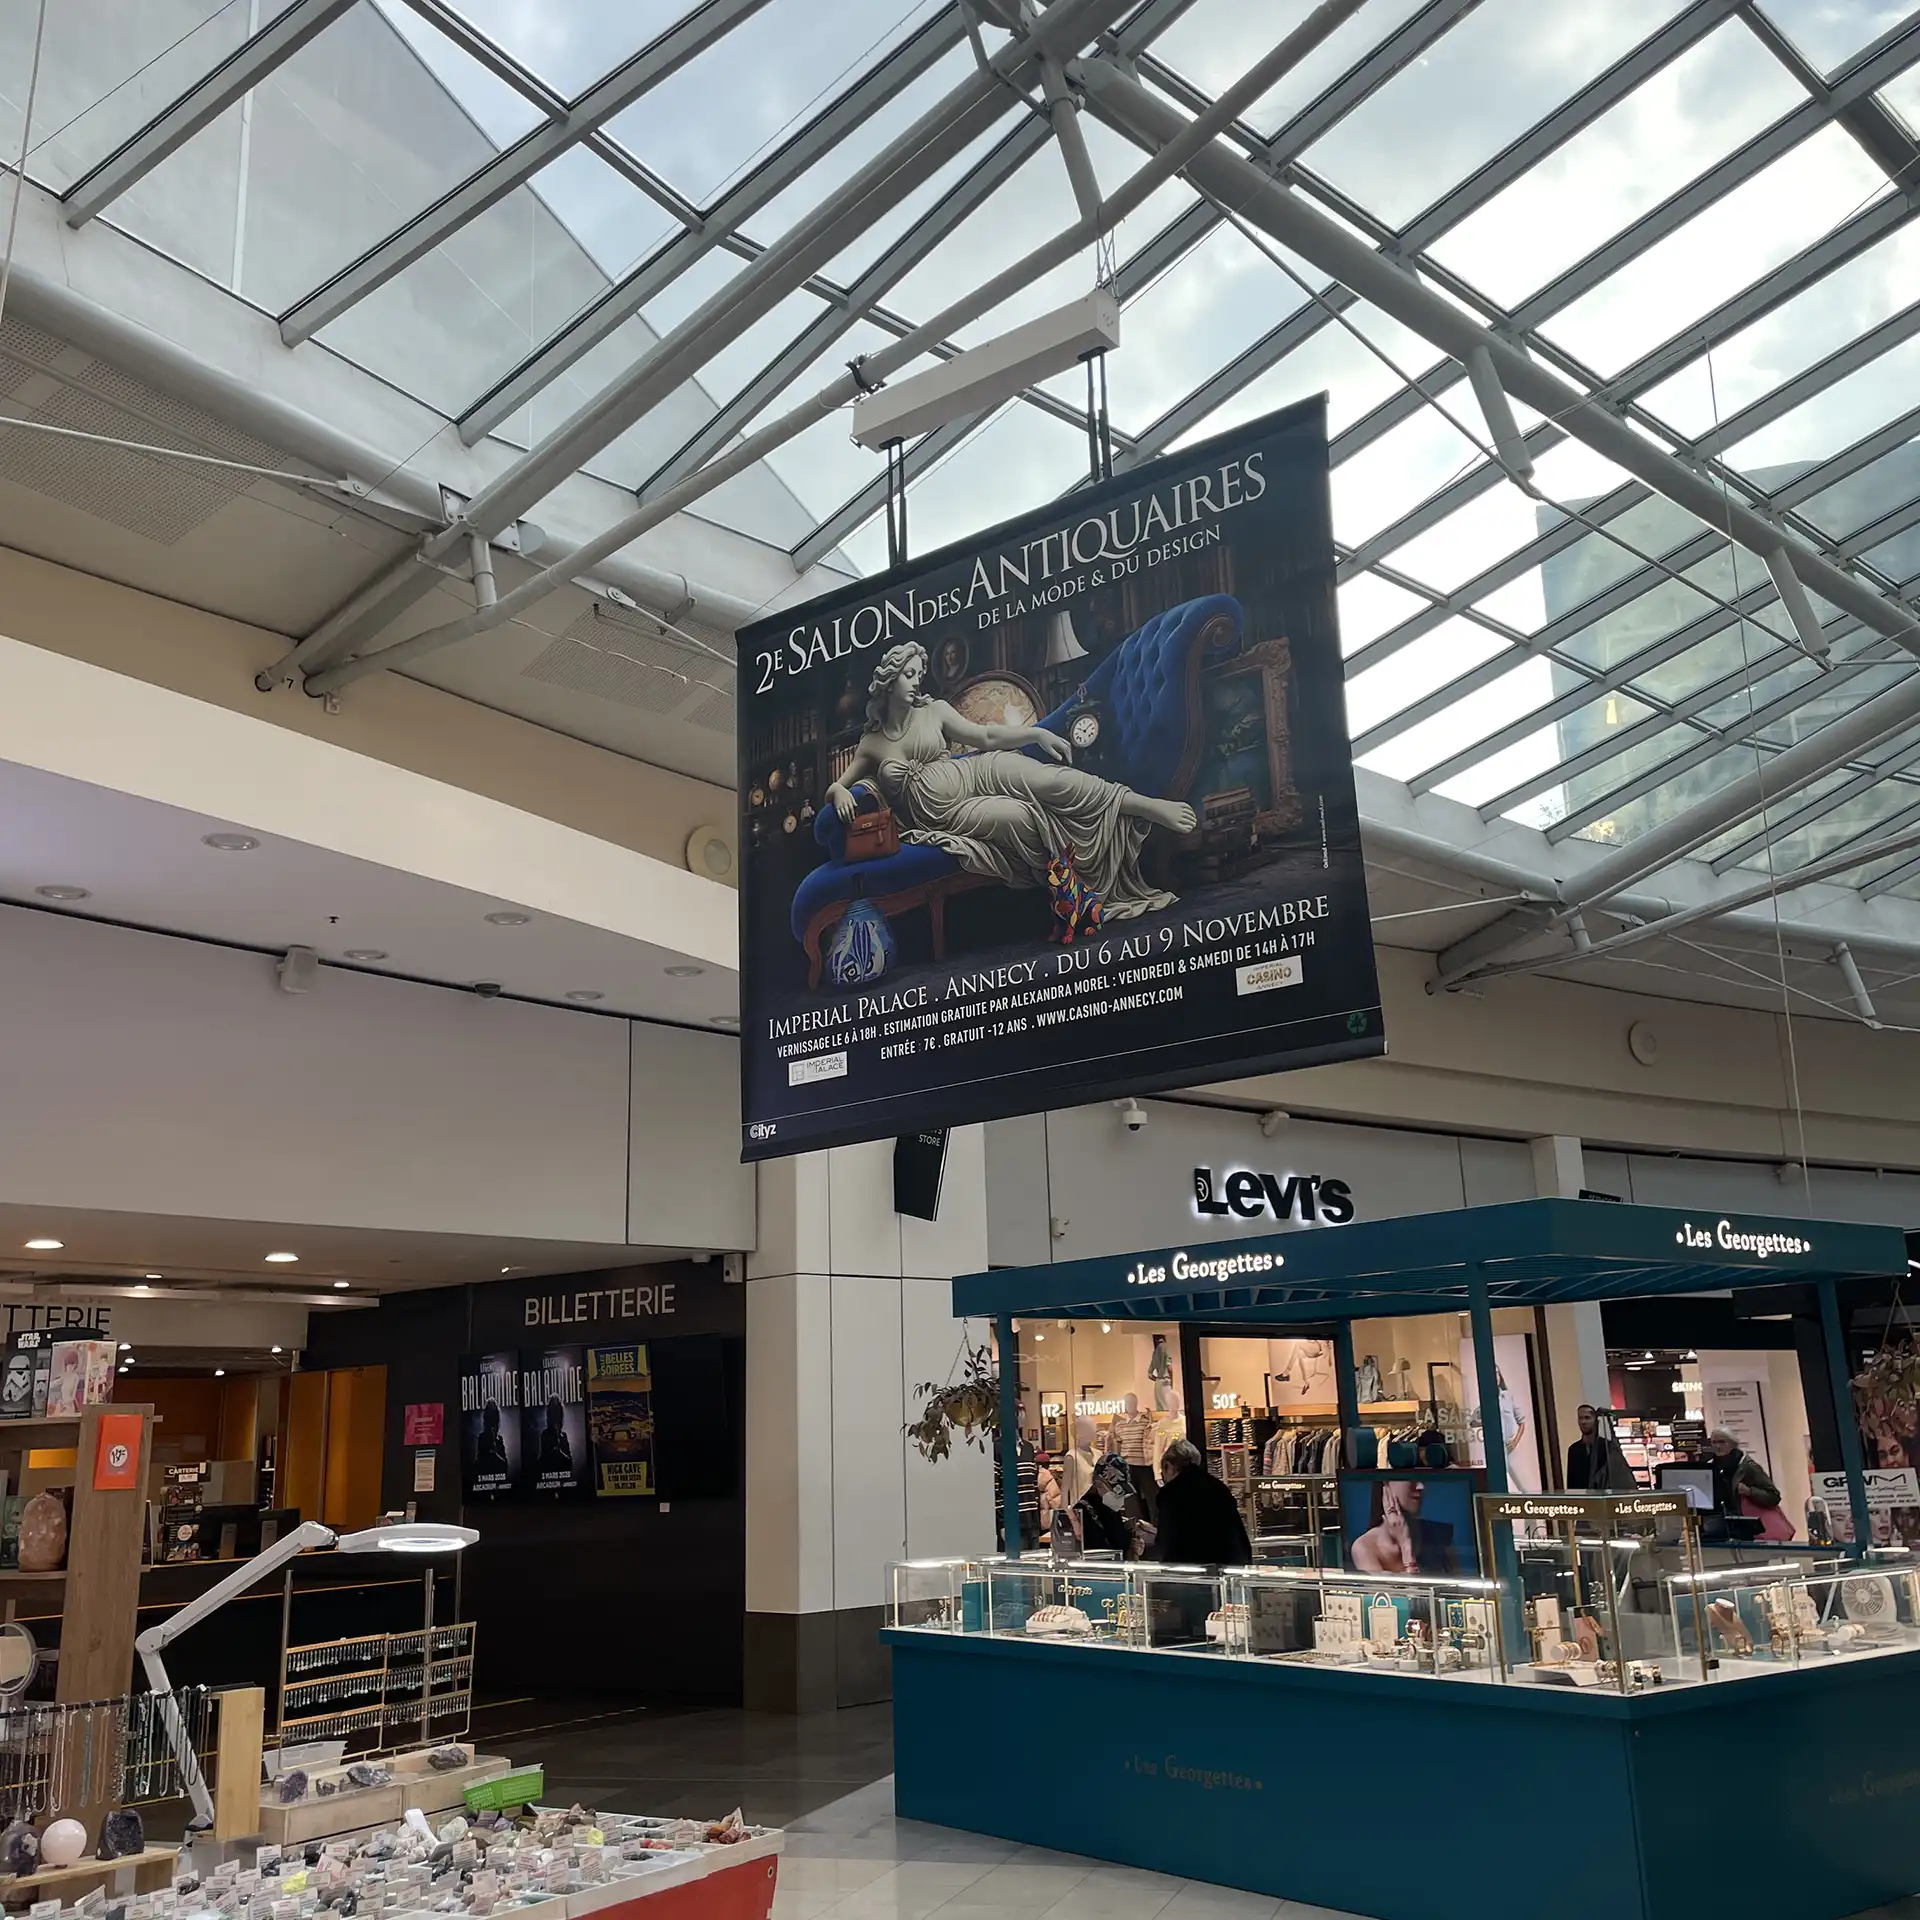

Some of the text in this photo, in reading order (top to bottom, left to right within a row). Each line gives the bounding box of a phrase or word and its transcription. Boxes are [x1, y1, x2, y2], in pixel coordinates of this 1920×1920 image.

[788, 588, 917, 676] SALON
[918, 587, 961, 627] DES
[962, 452, 1267, 610] ANTIQUAIRES
[977, 524, 1221, 629] DE LA MODE & DU DESIGN
[768, 895, 1330, 1040] IMPERIAL PALACE ANNECY DU 6 AU 9 NOVEMBRE
[1246, 966, 1292, 985] CASINO
[777, 931, 1315, 1059] VERNISSAGE LE 6 À 18H ESTIMATION GRATUITE PAR ALEXANDRA MOREL VENDREDI & SAMEDI DE 14H À 17H
[880, 1040, 916, 1060] ENTRÉE
[943, 1026, 985, 1047] GRATUIT
[1006, 1017, 1027, 1034] ANS
[1036, 985, 1184, 1028] WWW.CASINO-ANNECY.COM
[918, 1133, 941, 1147] STORE
[1684, 1220, 1802, 1258] Les Georgettes
[1137, 1252, 1273, 1284] Les Georgettes
[524, 1284, 675, 1326] BILLETTERIE
[1504, 1501, 1579, 1517] Les Georgettes
[1619, 1499, 1673, 1516] Les Georgettes
